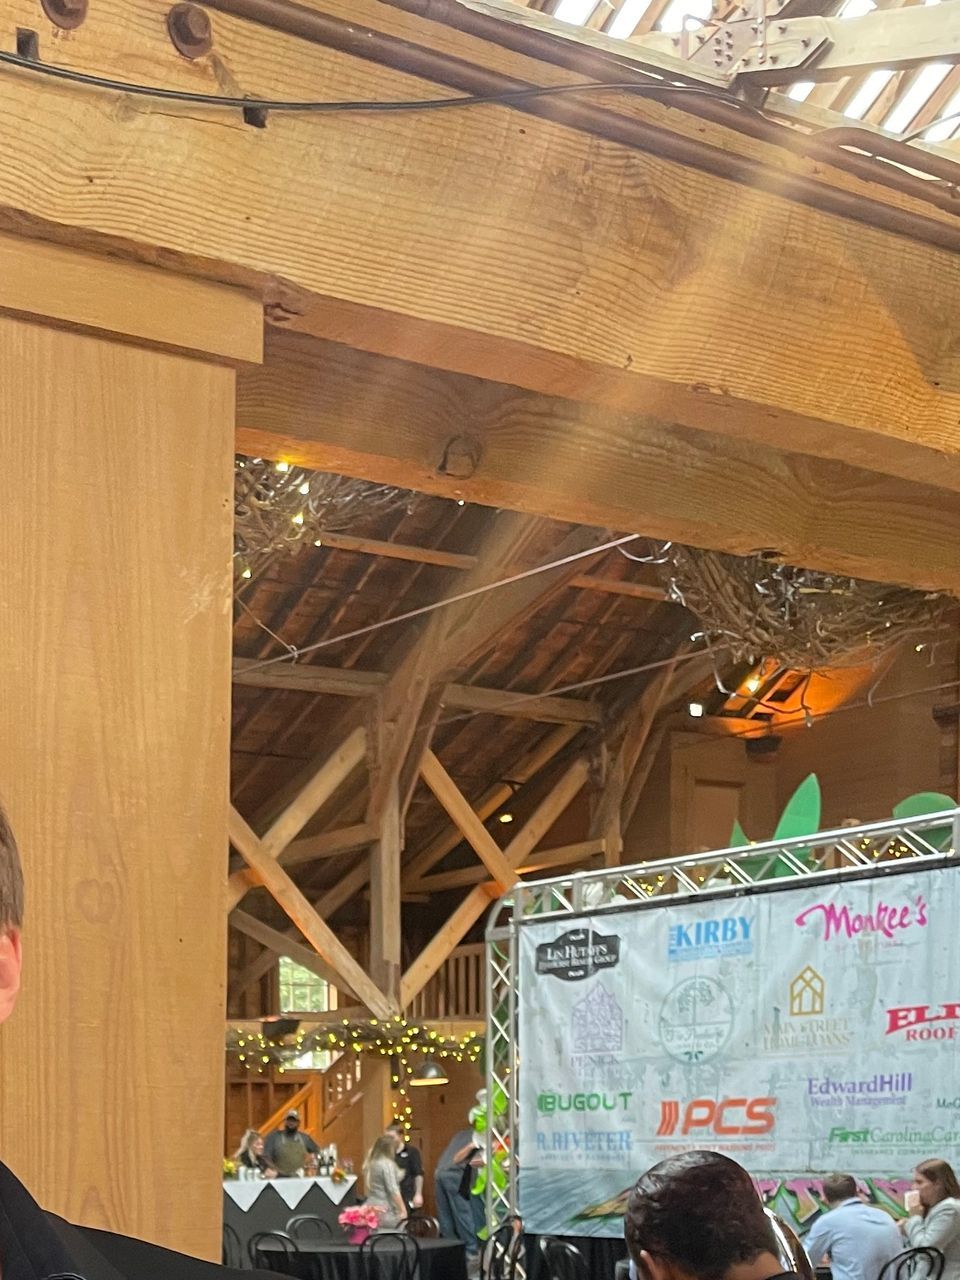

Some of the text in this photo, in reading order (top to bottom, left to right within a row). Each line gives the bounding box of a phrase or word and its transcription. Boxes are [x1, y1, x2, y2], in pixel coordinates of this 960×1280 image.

[676, 916, 755, 946] KIRBY
[795, 896, 927, 941] Monkee's
[808, 1073, 912, 1095] EdwardHill
[540, 1092, 632, 1111] BUGOUT
[681, 1097, 776, 1136] PCS
